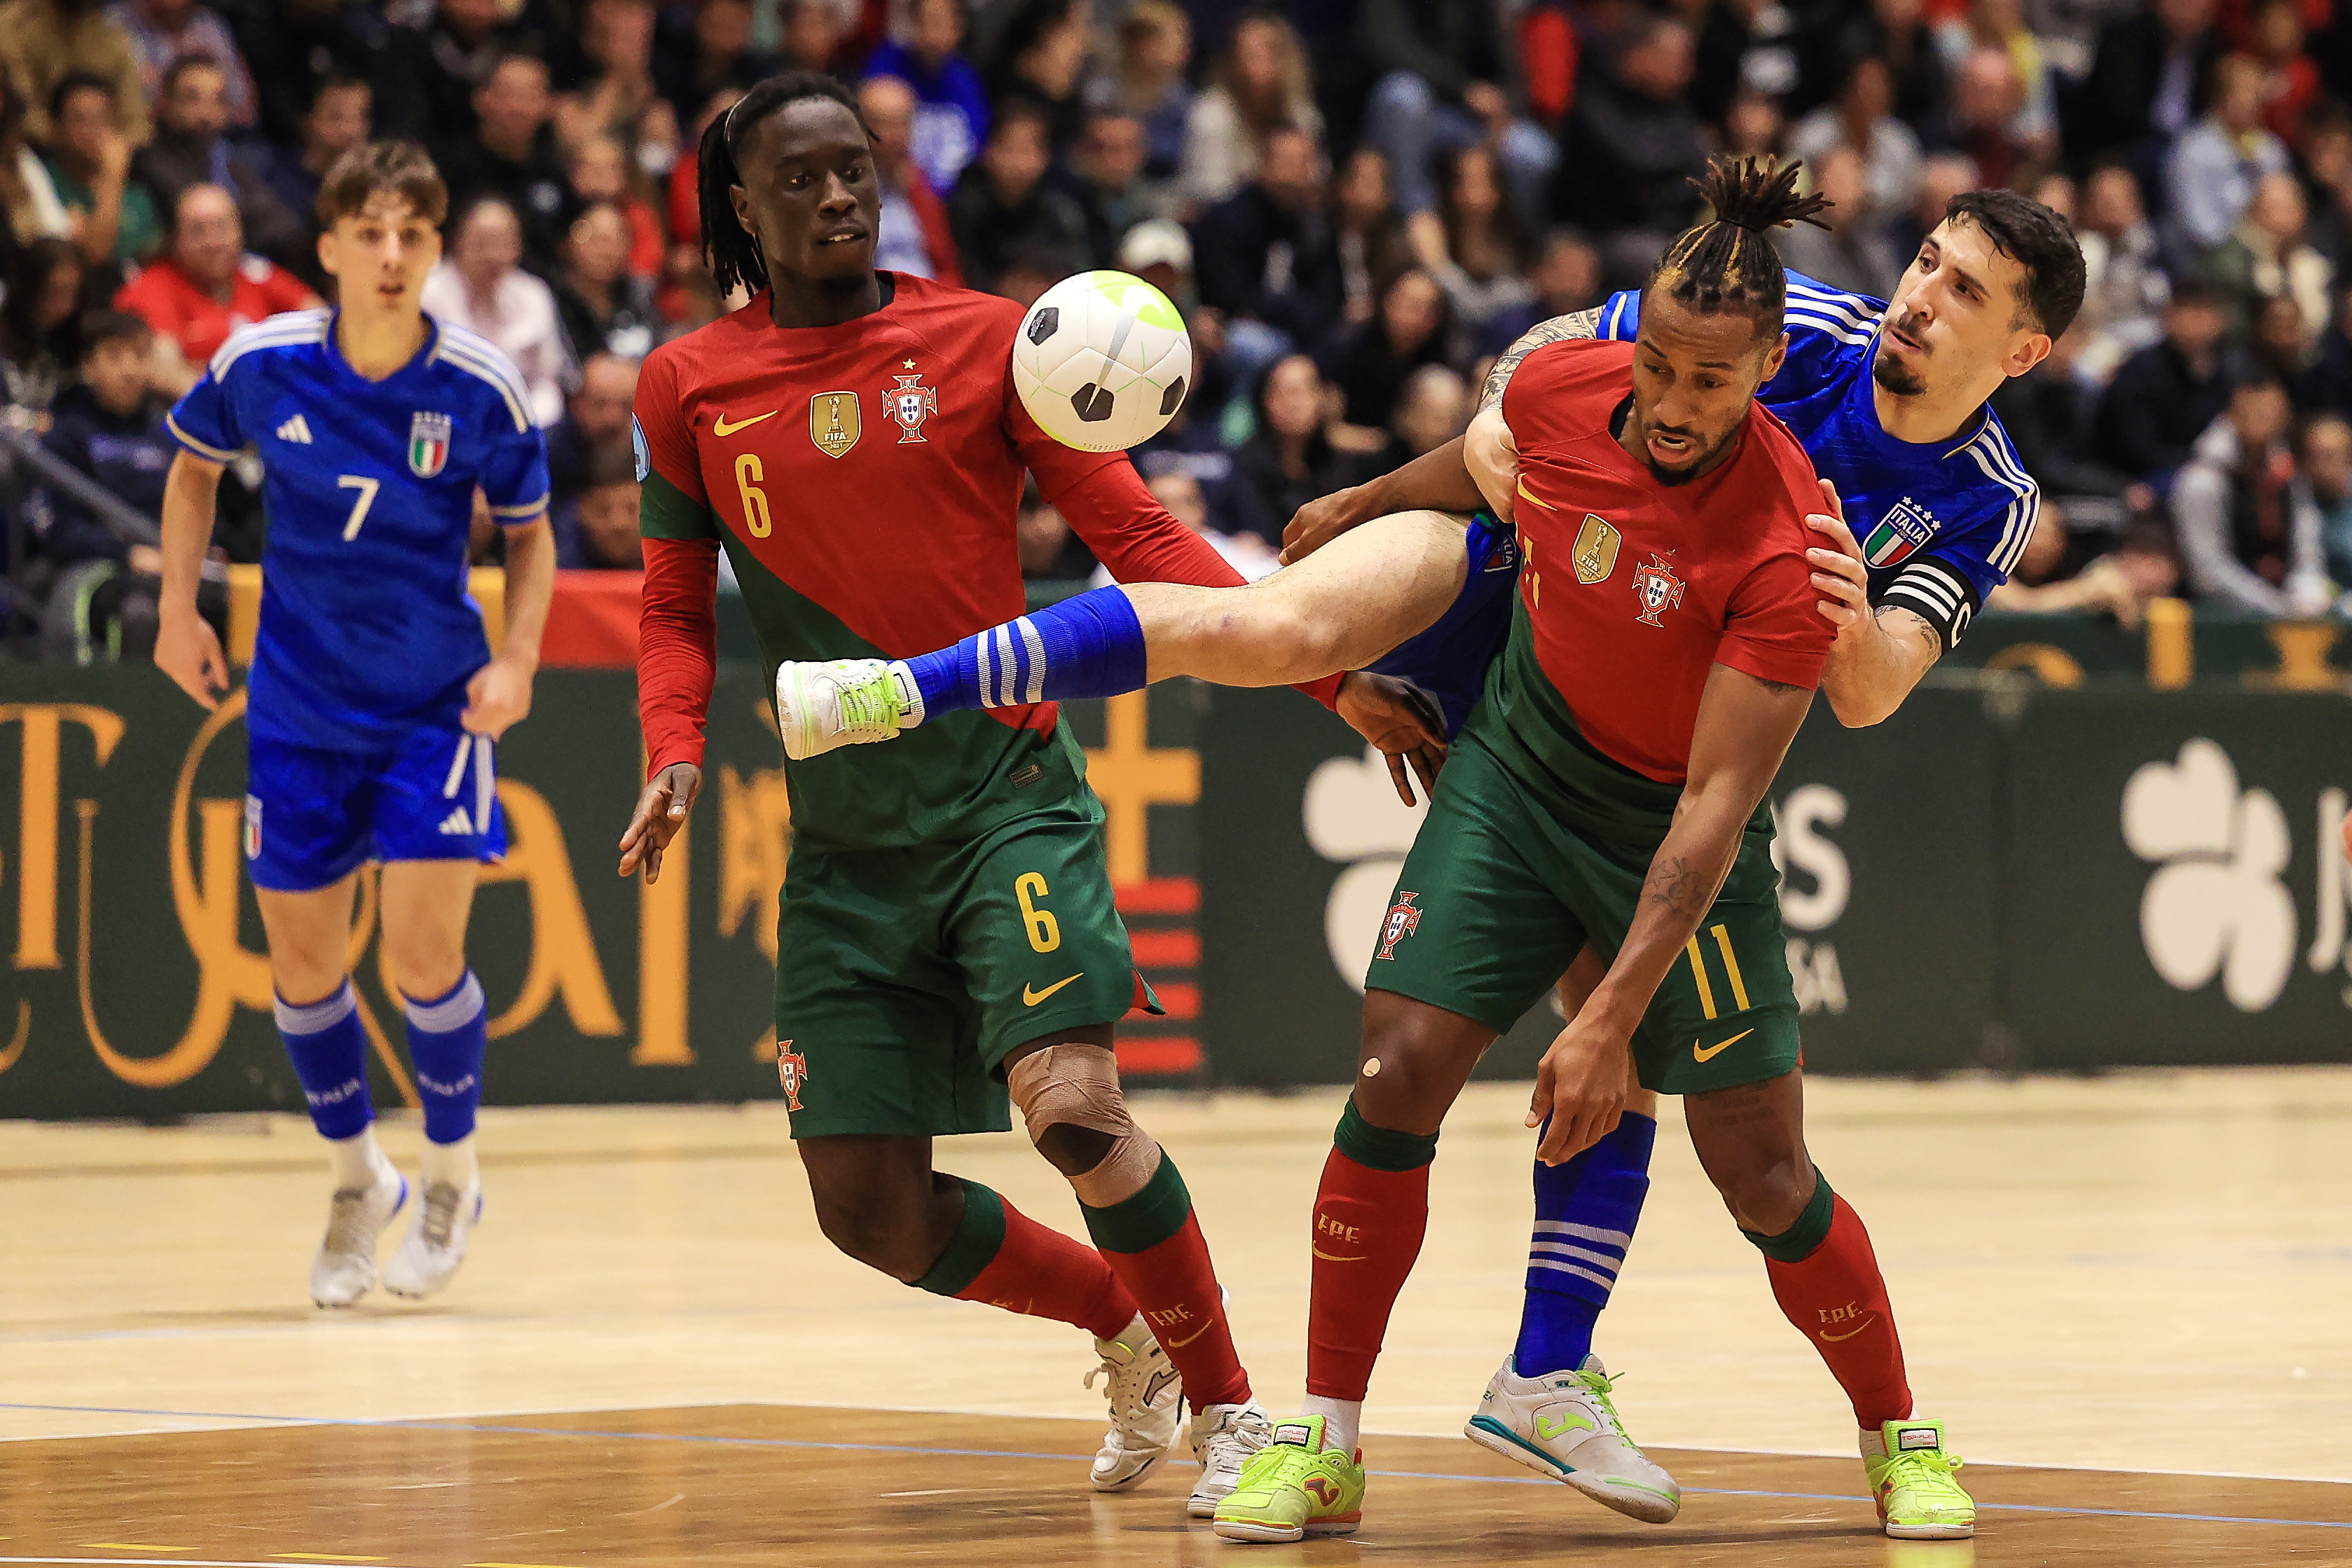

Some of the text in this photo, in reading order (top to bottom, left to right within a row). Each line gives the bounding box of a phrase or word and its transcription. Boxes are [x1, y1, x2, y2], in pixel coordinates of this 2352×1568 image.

[824, 432, 846, 441] FIFA
[337, 474, 380, 542] 7
[735, 453, 772, 538] 6
[1891, 509, 1925, 543] ITALIA
[1581, 554, 1598, 572] FIFA
[1015, 872, 1061, 953] 6
[1686, 923, 1751, 1020] 11
